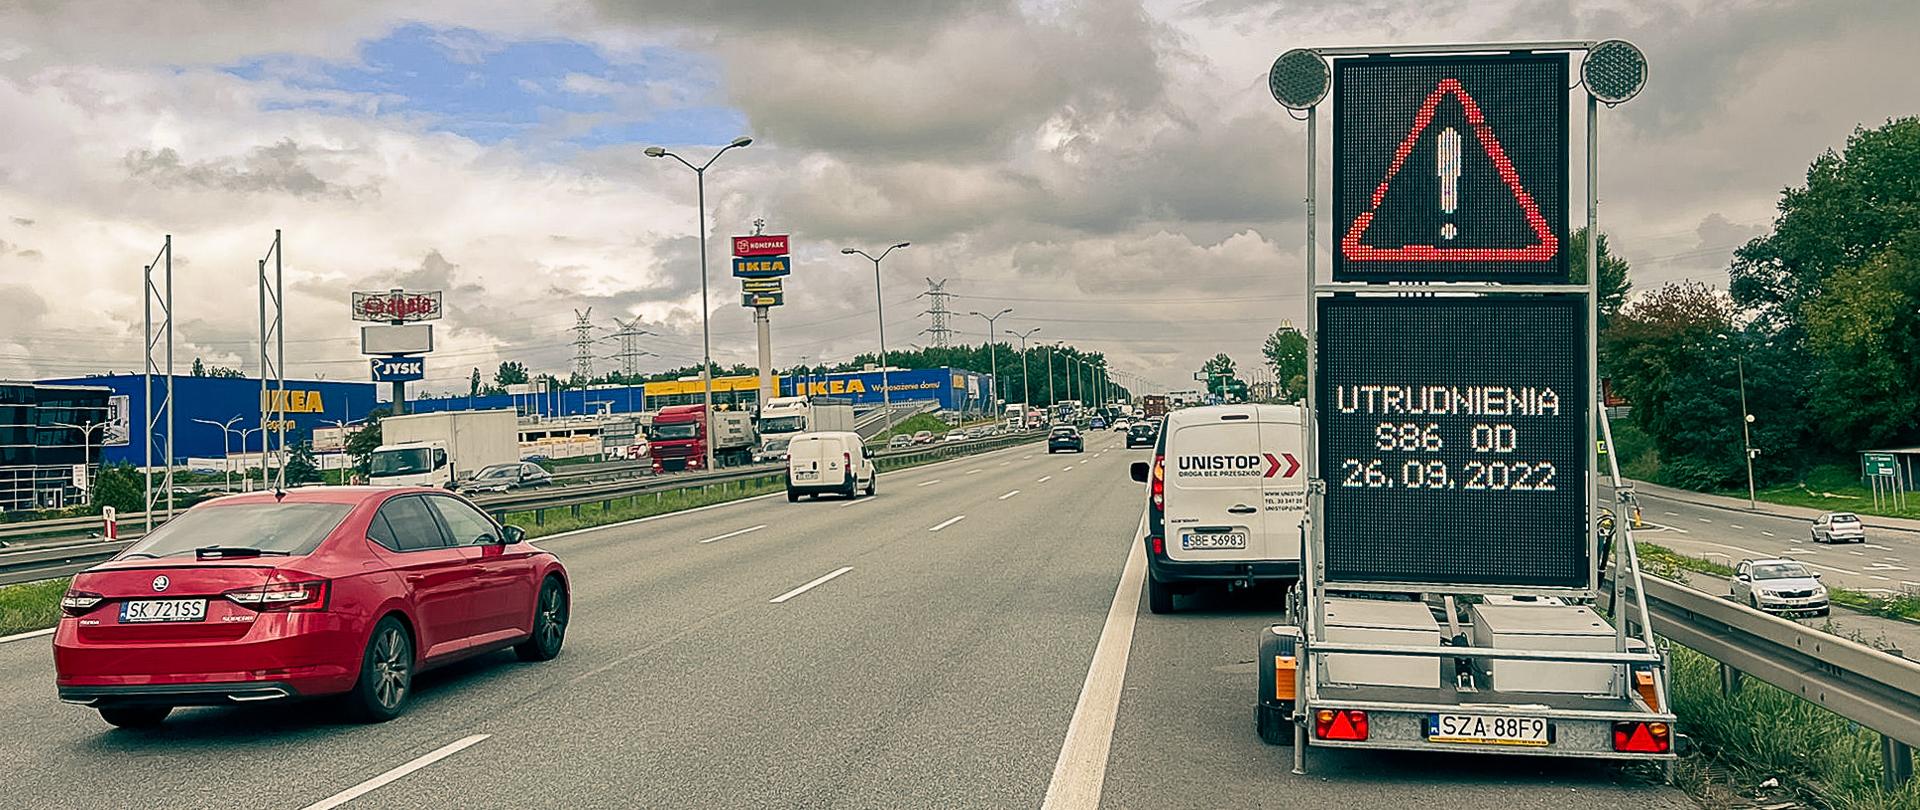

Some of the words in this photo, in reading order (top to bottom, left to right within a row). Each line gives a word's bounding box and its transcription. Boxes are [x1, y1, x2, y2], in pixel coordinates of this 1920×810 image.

[750, 241, 784, 249] HOMEPARK
[738, 261, 785, 272] IKEA
[383, 363, 421, 375] JYSK
[796, 379, 866, 396] IKEA
[260, 389, 324, 413] IKEA
[1338, 385, 1559, 416] UTRUDNIENIA
[1376, 422, 1443, 451] S86
[1471, 423, 1517, 453] OD
[1178, 455, 1261, 470] UNISTOP
[1342, 458, 1556, 491] 26.09.2022
[1189, 535, 1210, 546] SBE
[1211, 534, 1244, 546] 56983
[129, 602, 149, 618] SK
[152, 601, 201, 617] 721SS
[1443, 716, 1487, 737] SZA
[1494, 718, 1544, 739] 88F9
